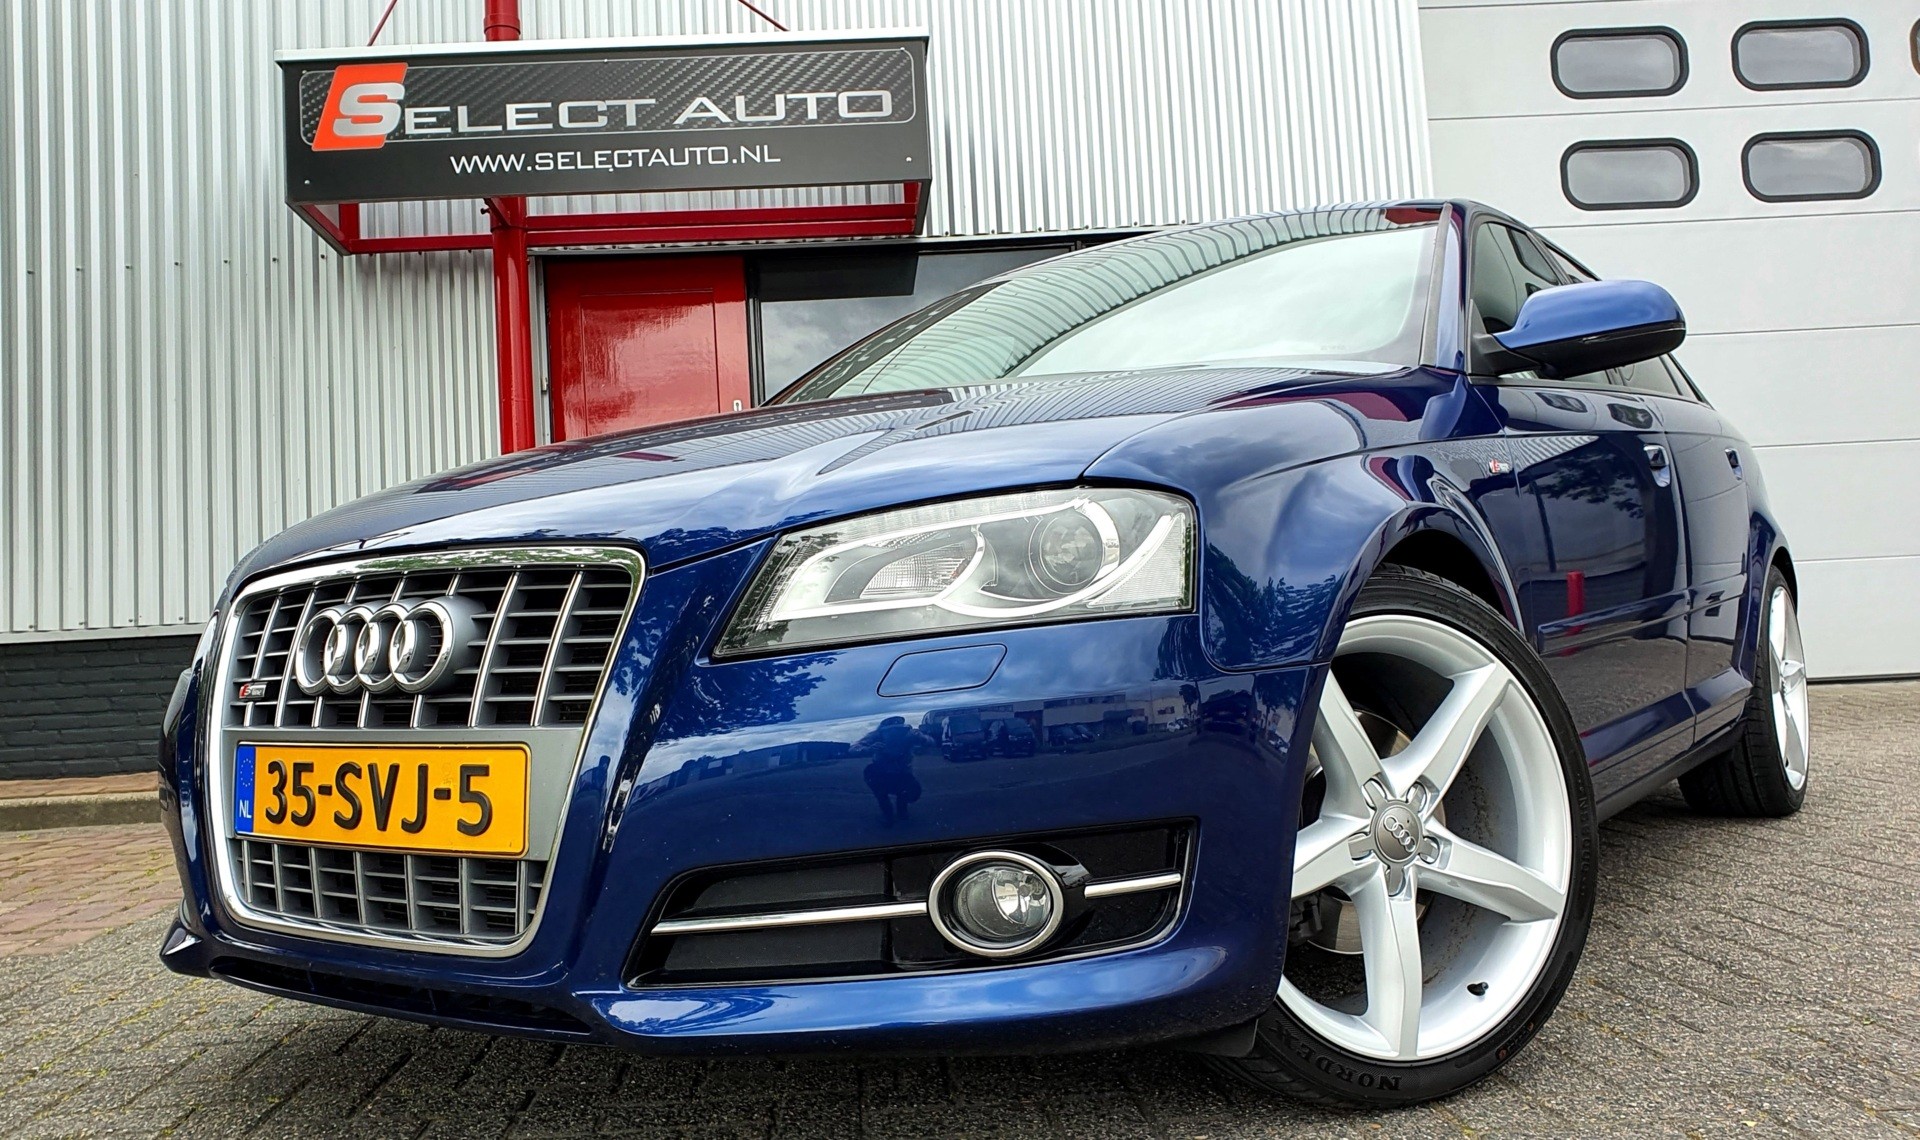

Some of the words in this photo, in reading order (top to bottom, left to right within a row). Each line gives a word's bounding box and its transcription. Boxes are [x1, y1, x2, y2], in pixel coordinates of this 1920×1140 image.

[333, 82, 656, 136] SELECT
[673, 90, 892, 125] AUTO
[450, 144, 781, 174] WWW.SELECTAUTO.NL
[239, 799, 252, 818] NL
[265, 759, 494, 837] 35-SVJ-5
